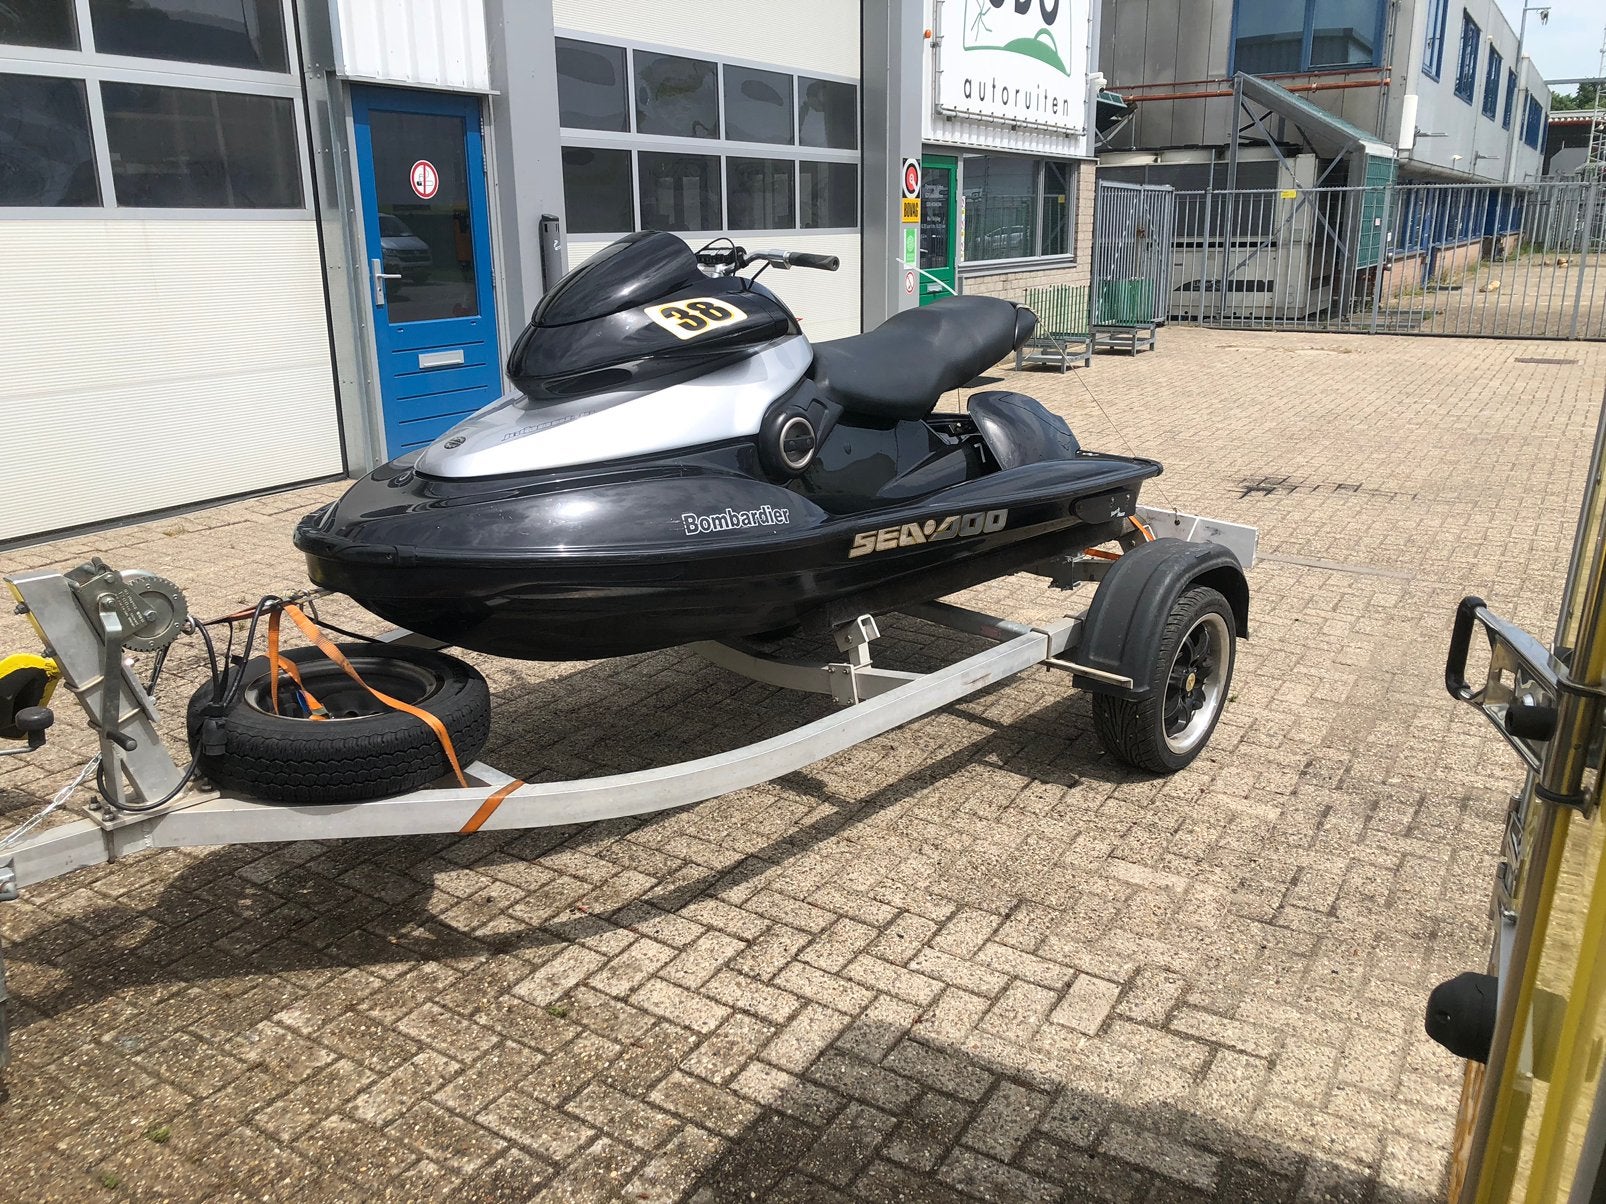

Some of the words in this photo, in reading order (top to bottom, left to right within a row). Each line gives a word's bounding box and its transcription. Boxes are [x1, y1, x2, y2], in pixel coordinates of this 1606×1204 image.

[963, 77, 1069, 117] autoruiten
[903, 202, 919, 218] BOVAG
[660, 301, 732, 331] 38
[682, 505, 789, 535] Bombardier
